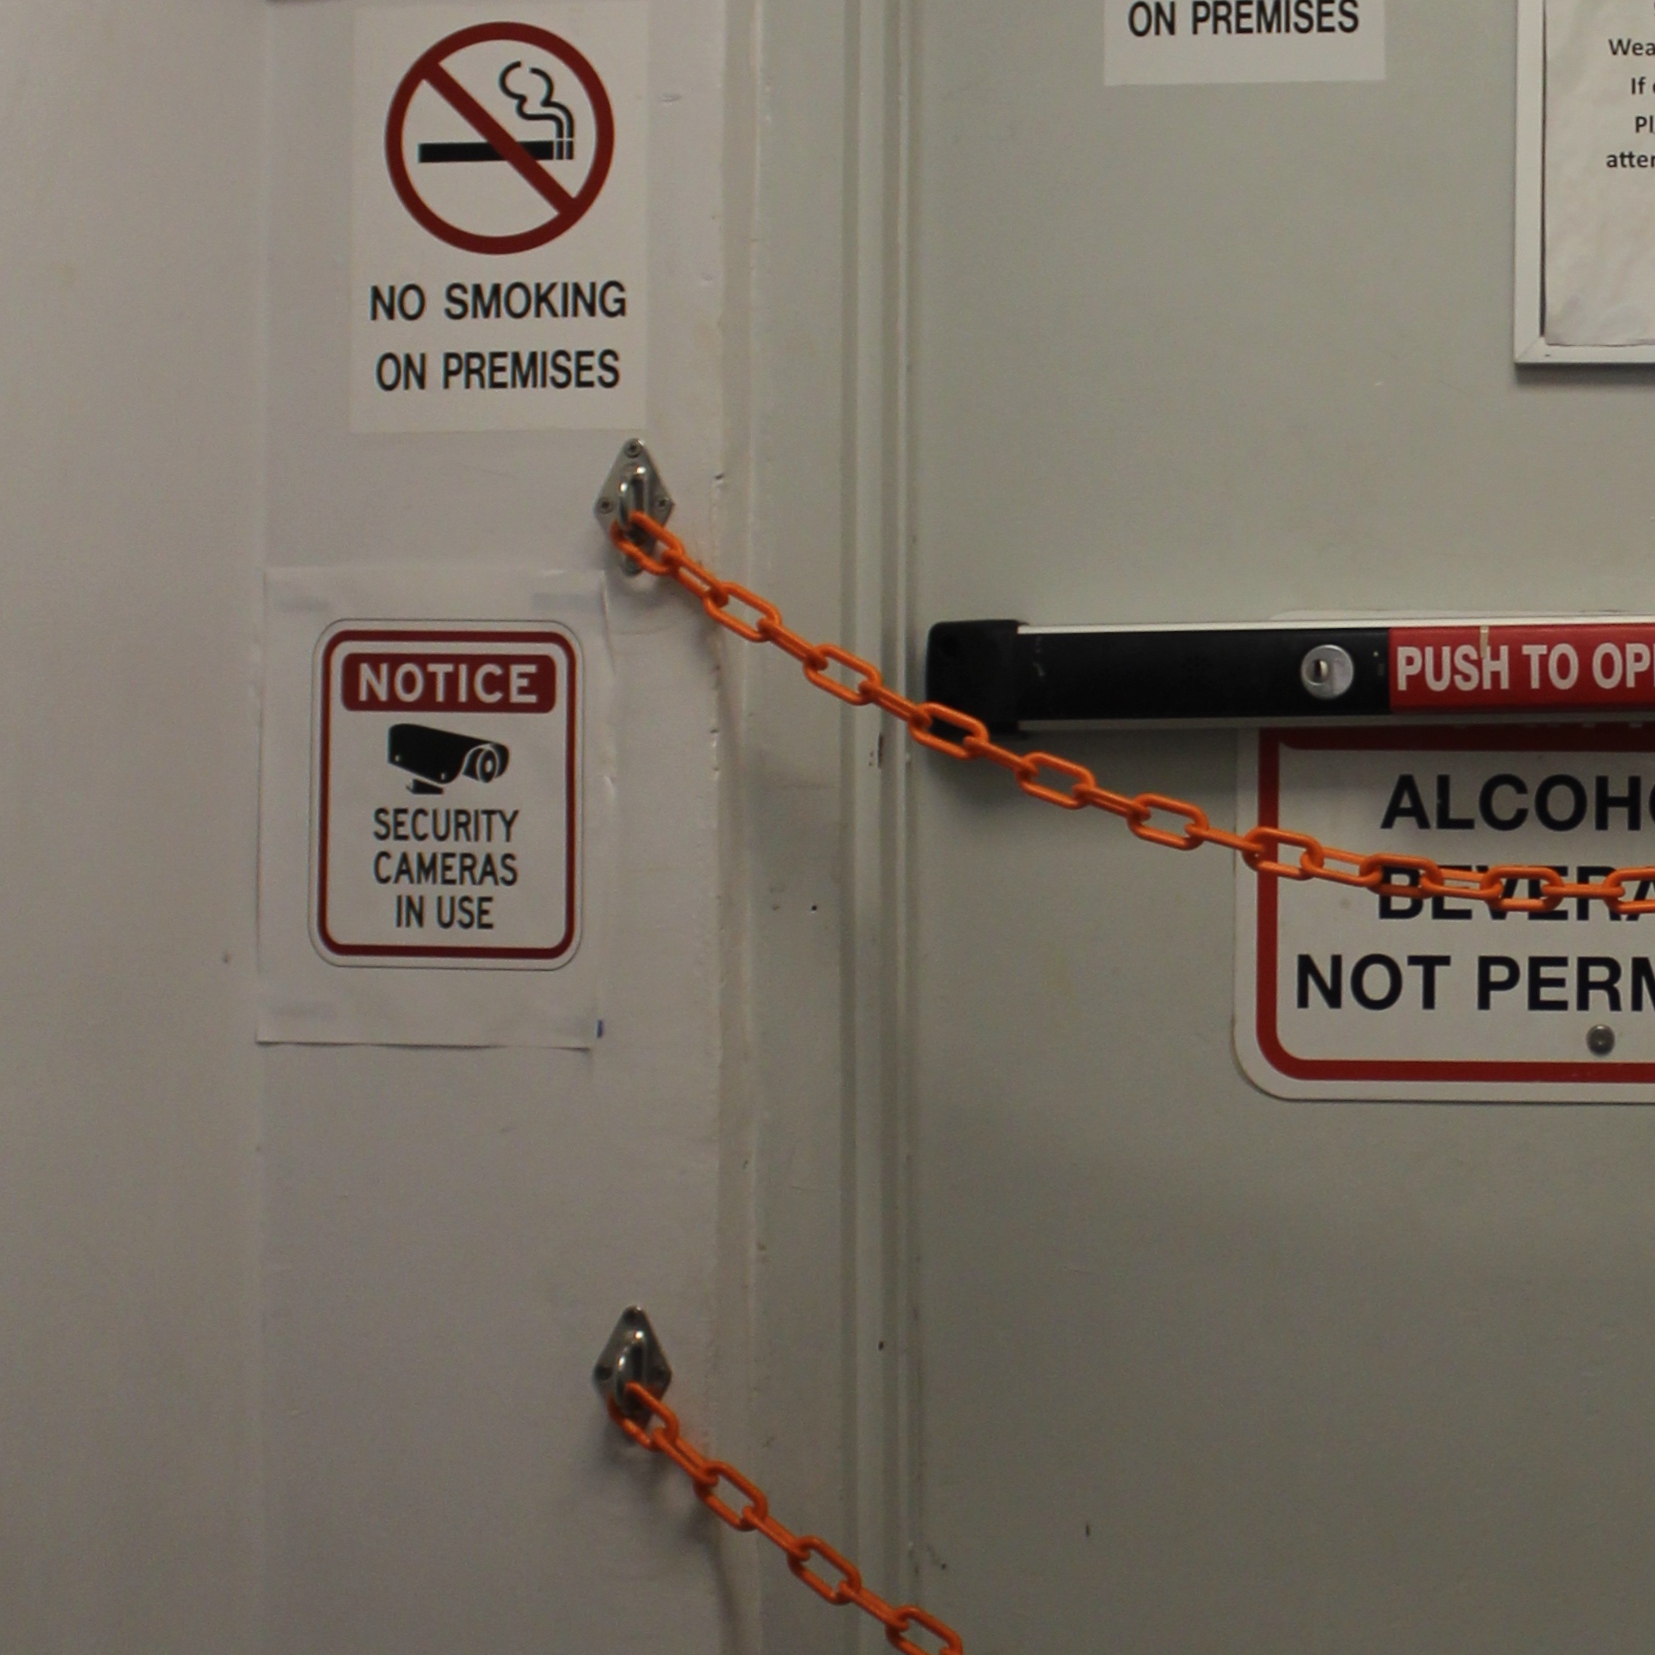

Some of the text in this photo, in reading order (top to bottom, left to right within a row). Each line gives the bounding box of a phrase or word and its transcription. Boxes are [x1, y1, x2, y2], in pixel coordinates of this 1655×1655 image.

[1128, 0, 1176, 38] ON
[1631, 76, 1646, 95] If
[370, 279, 627, 322] NO SMOKING
[375, 348, 620, 392] ON PREMISES
[358, 662, 538, 704] NOTICE
[1396, 644, 1510, 692] PUSH
[1521, 642, 1580, 690] TO
[373, 807, 520, 843] SECURITY
[373, 850, 518, 887] CAMERAS
[396, 894, 494, 930] IN USE
[1296, 953, 1452, 1011] NOT
